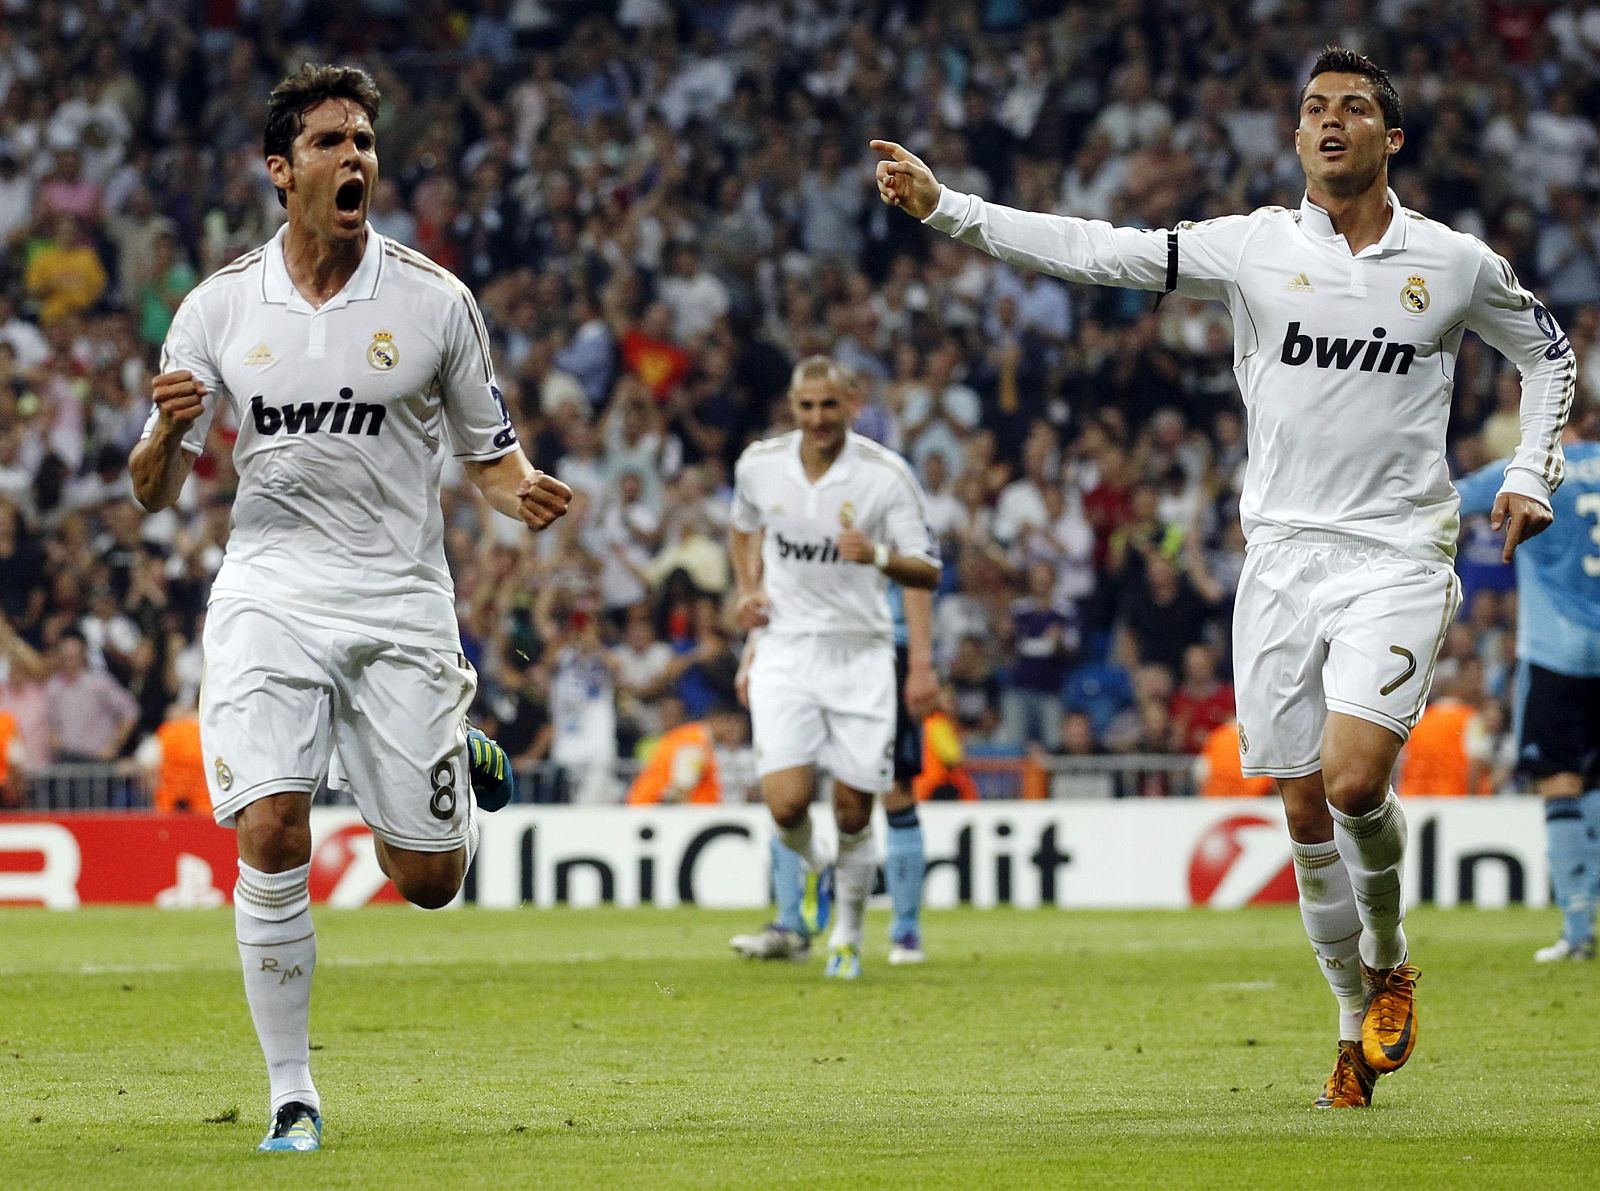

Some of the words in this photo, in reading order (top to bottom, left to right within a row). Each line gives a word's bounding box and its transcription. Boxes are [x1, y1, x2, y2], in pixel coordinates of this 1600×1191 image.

[1281, 321, 1416, 375] bwin
[251, 387, 386, 436] bwin
[1380, 645, 1416, 696] 7
[430, 761, 456, 820] 8
